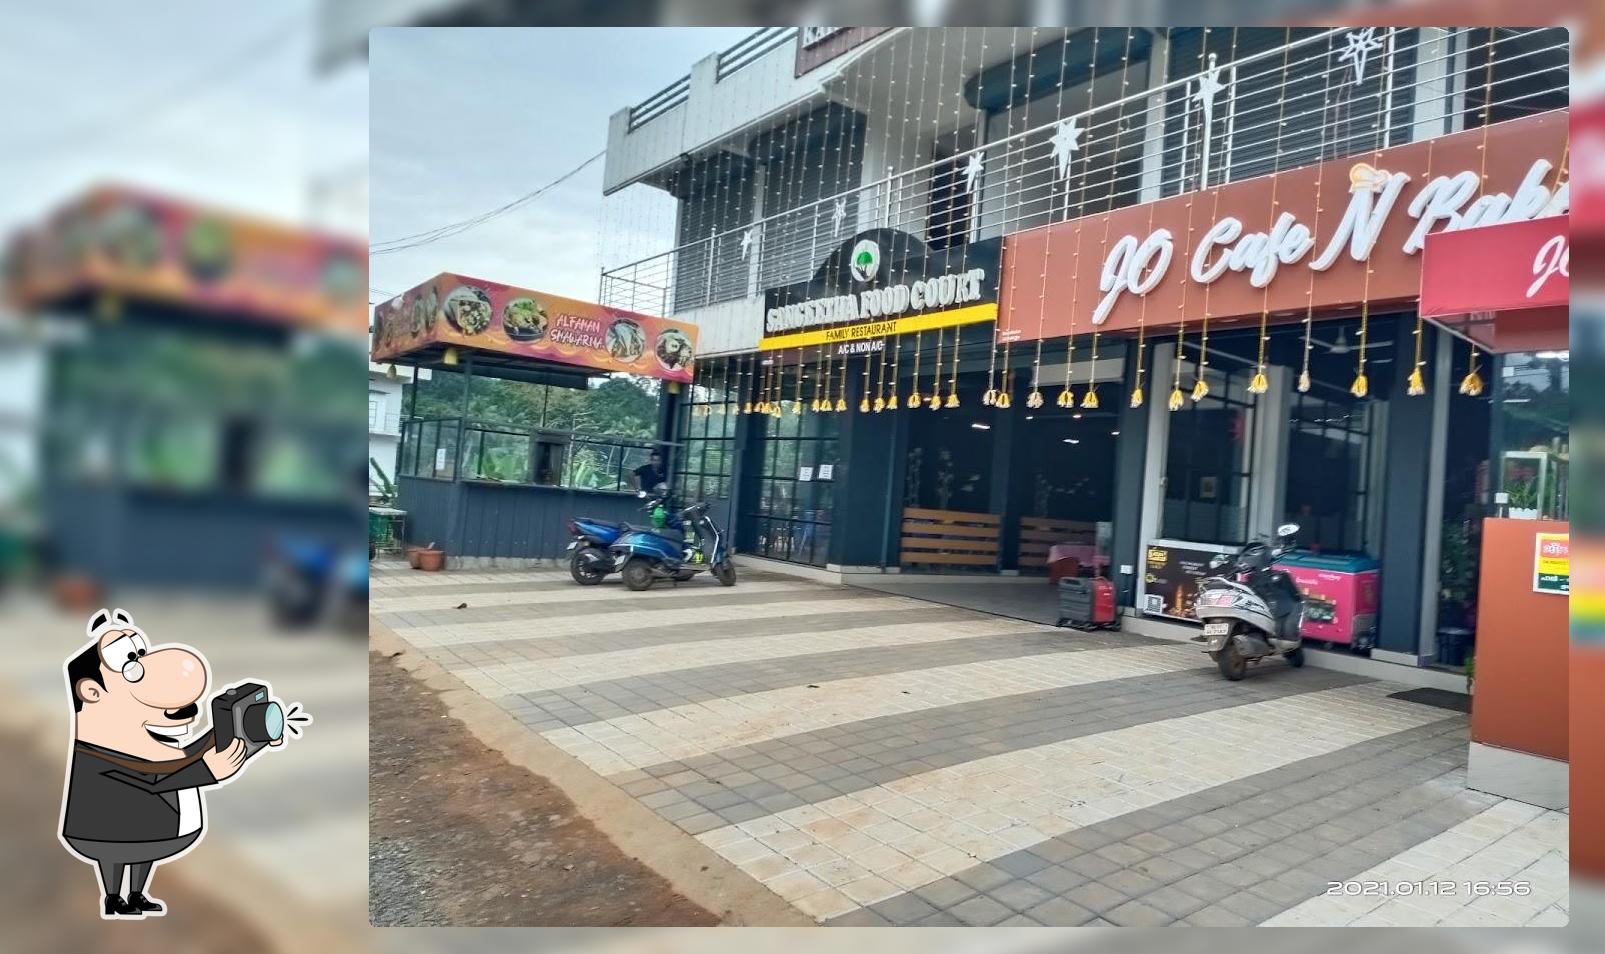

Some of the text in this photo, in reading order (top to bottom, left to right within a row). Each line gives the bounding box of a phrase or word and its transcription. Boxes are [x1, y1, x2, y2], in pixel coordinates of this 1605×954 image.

[1092, 228, 1174, 325] JO
[1191, 211, 1316, 289] Cafe
[1308, 168, 1411, 272] N
[860, 284, 910, 319] FOOD
[911, 267, 985, 310] COURT
[826, 321, 897, 341] FAMILY RESTAURANT
[855, 341, 871, 353] NON
